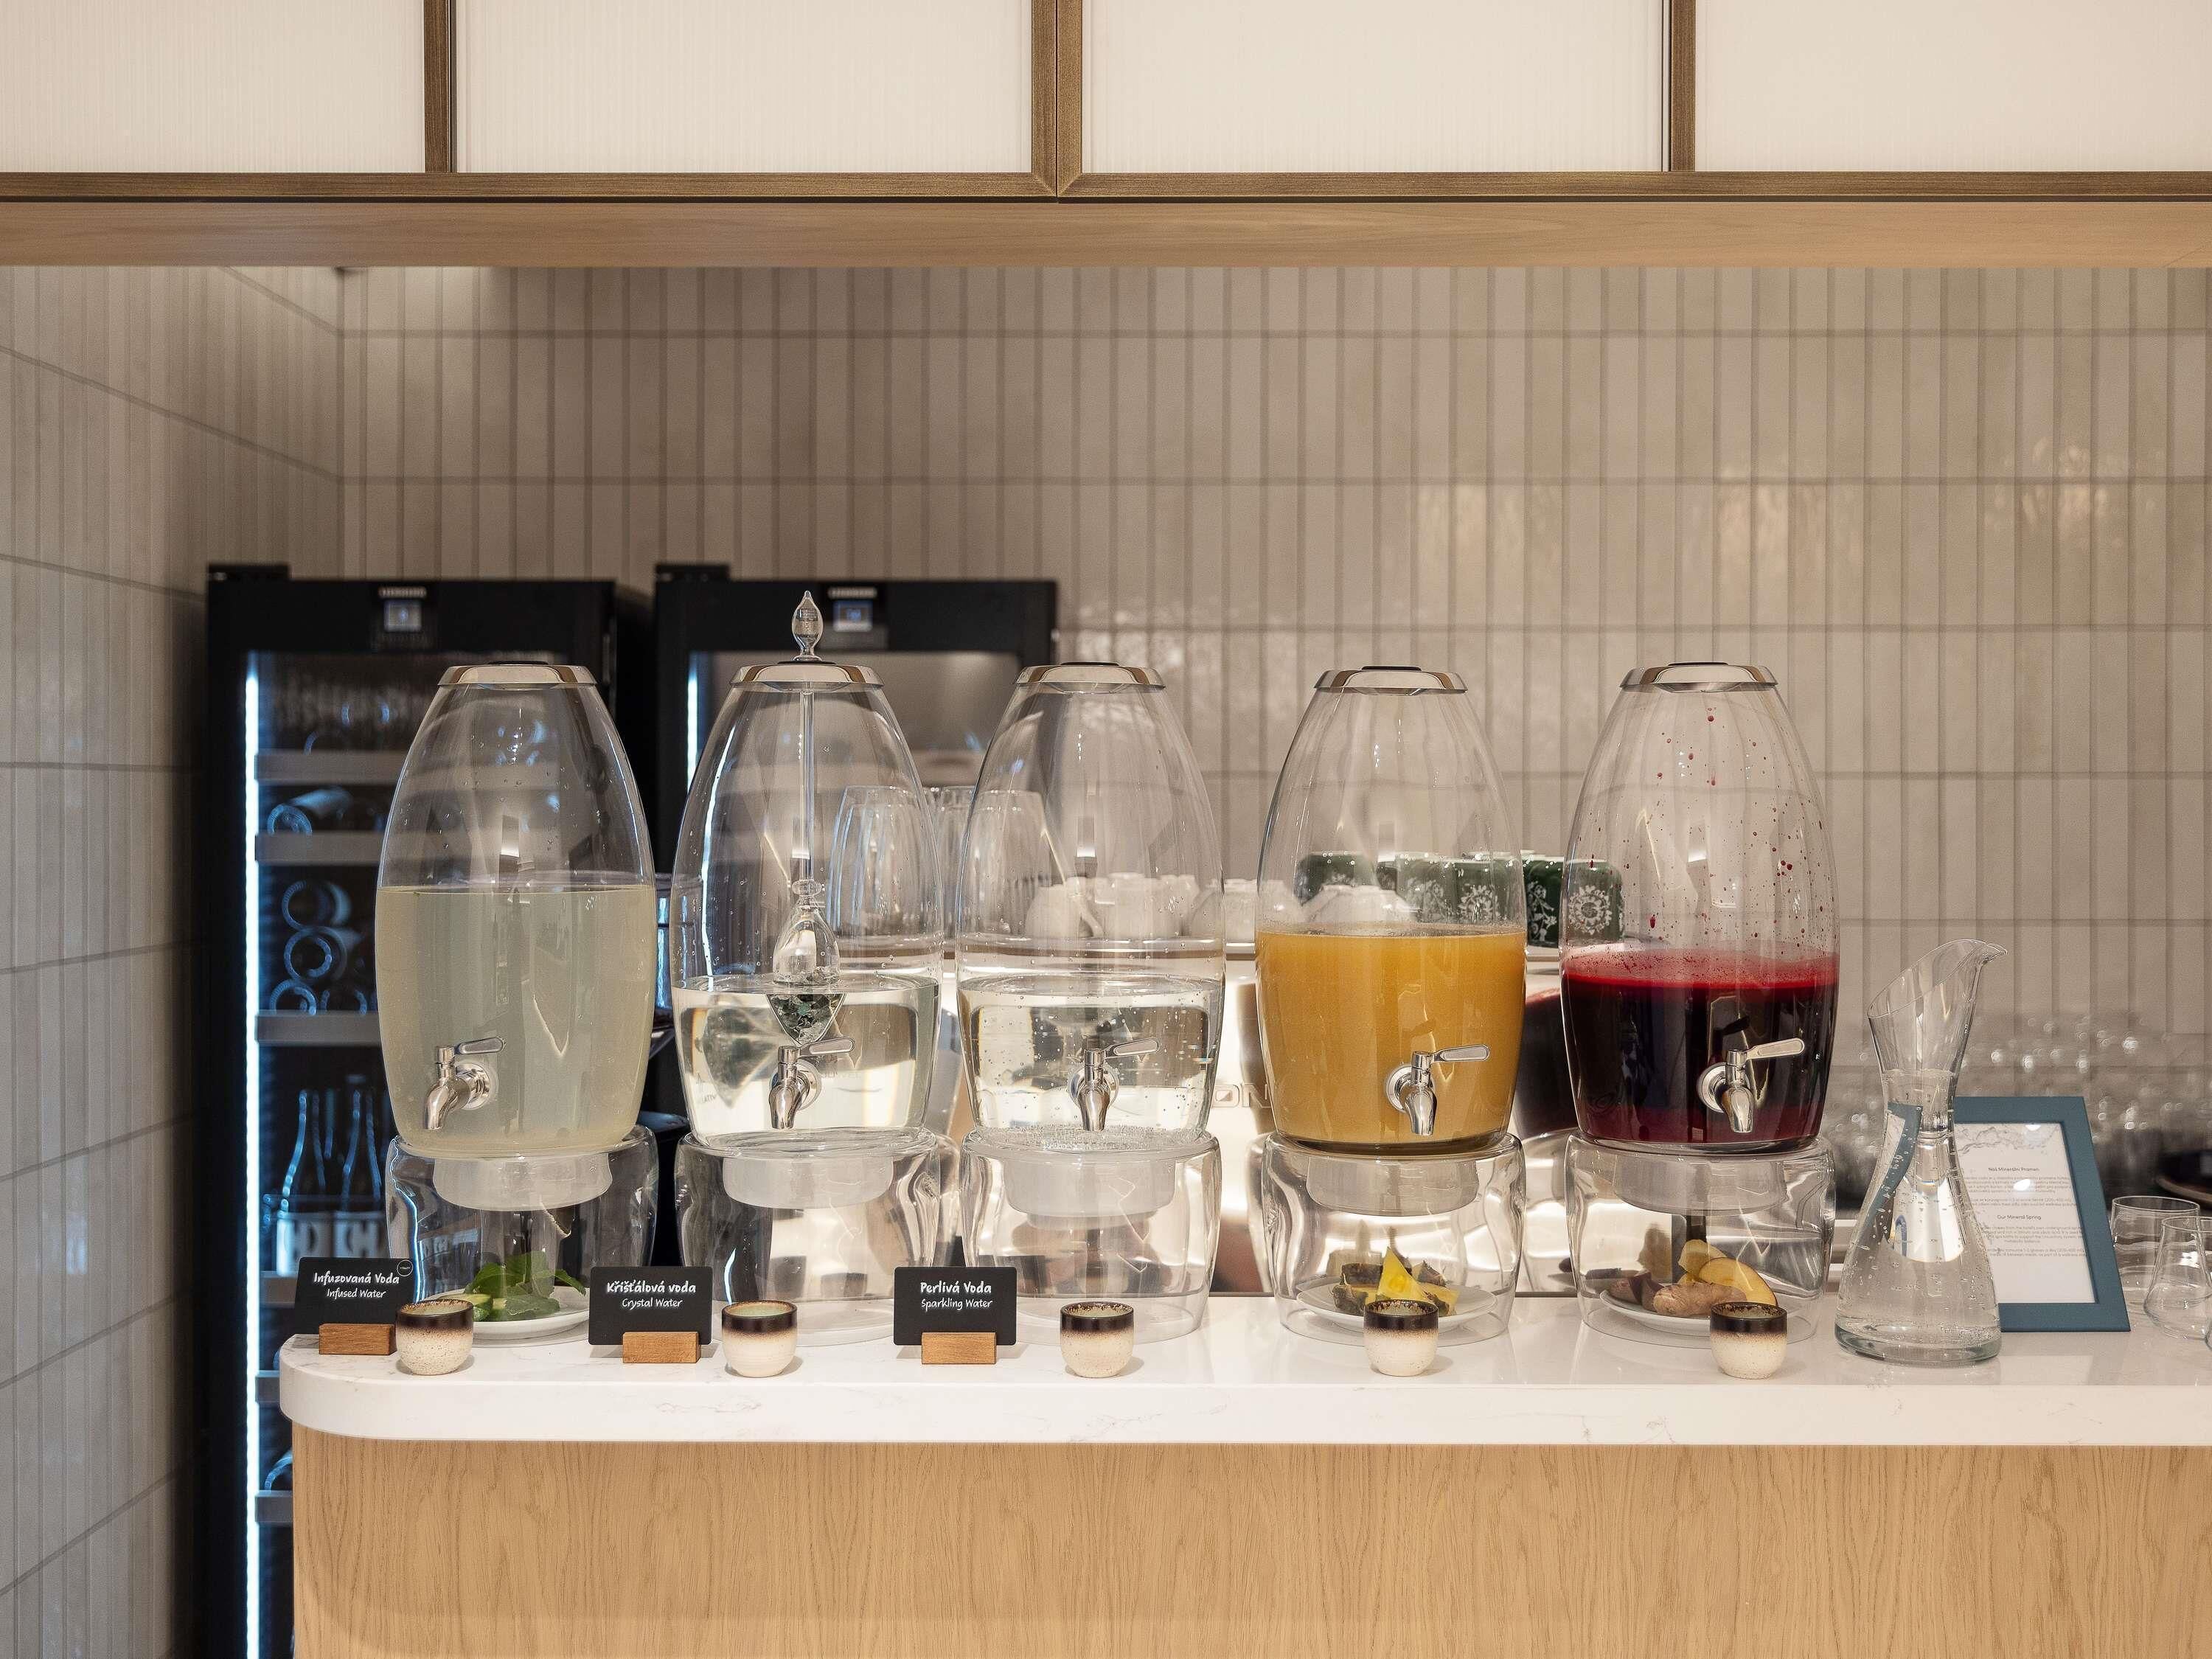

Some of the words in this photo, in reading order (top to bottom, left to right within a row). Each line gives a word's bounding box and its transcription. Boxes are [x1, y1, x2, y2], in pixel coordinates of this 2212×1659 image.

[313, 1270, 372, 1286] Infuzovaná
[375, 1272, 400, 1284] Voda
[607, 1279, 665, 1293] Křišťálová
[669, 1281, 697, 1293] voda
[920, 1280, 960, 1294] Perlivá
[964, 1281, 992, 1293] Voda
[327, 1287, 358, 1300] Infused
[360, 1290, 386, 1298] Water
[622, 1298, 653, 1310] Crystal
[655, 1298, 683, 1307] Water
[921, 1298, 963, 1312] Sparkling
[965, 1298, 993, 1308] Water
